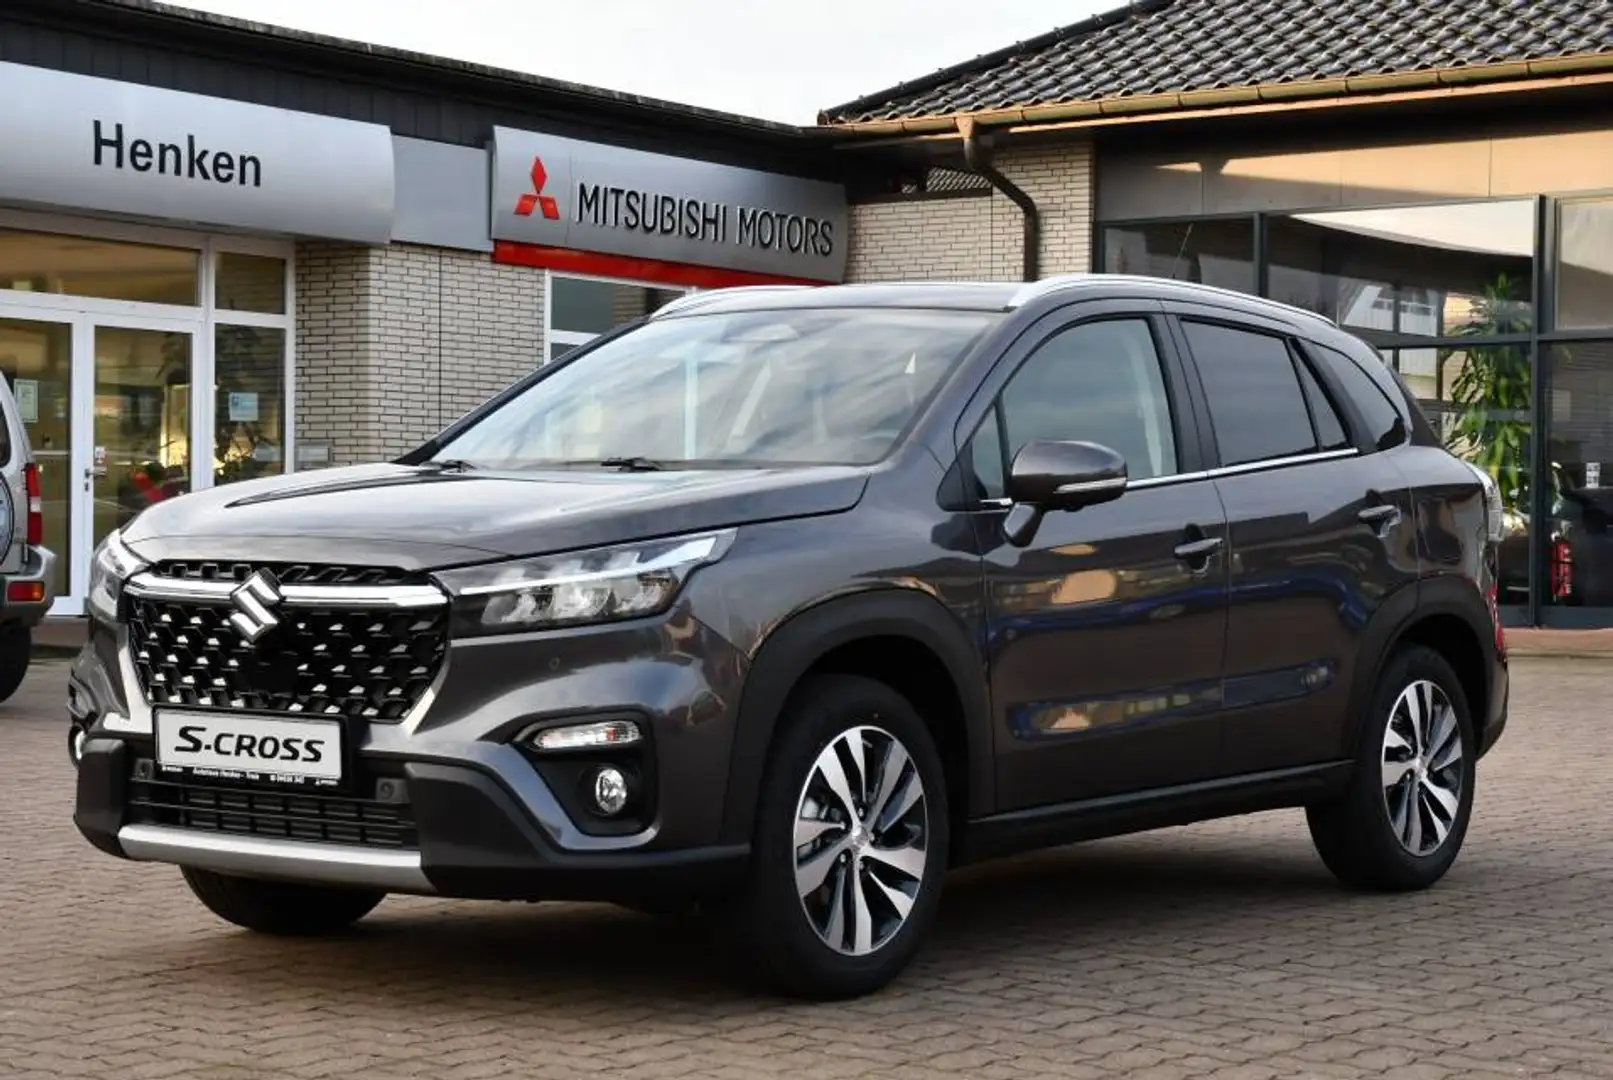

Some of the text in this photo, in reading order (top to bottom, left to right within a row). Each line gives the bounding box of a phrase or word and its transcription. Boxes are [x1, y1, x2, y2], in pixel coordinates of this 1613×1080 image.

[93, 119, 262, 187] Henken
[577, 182, 834, 257] MITSUBISHI MOTORS
[174, 725, 325, 762] S-CROSS
